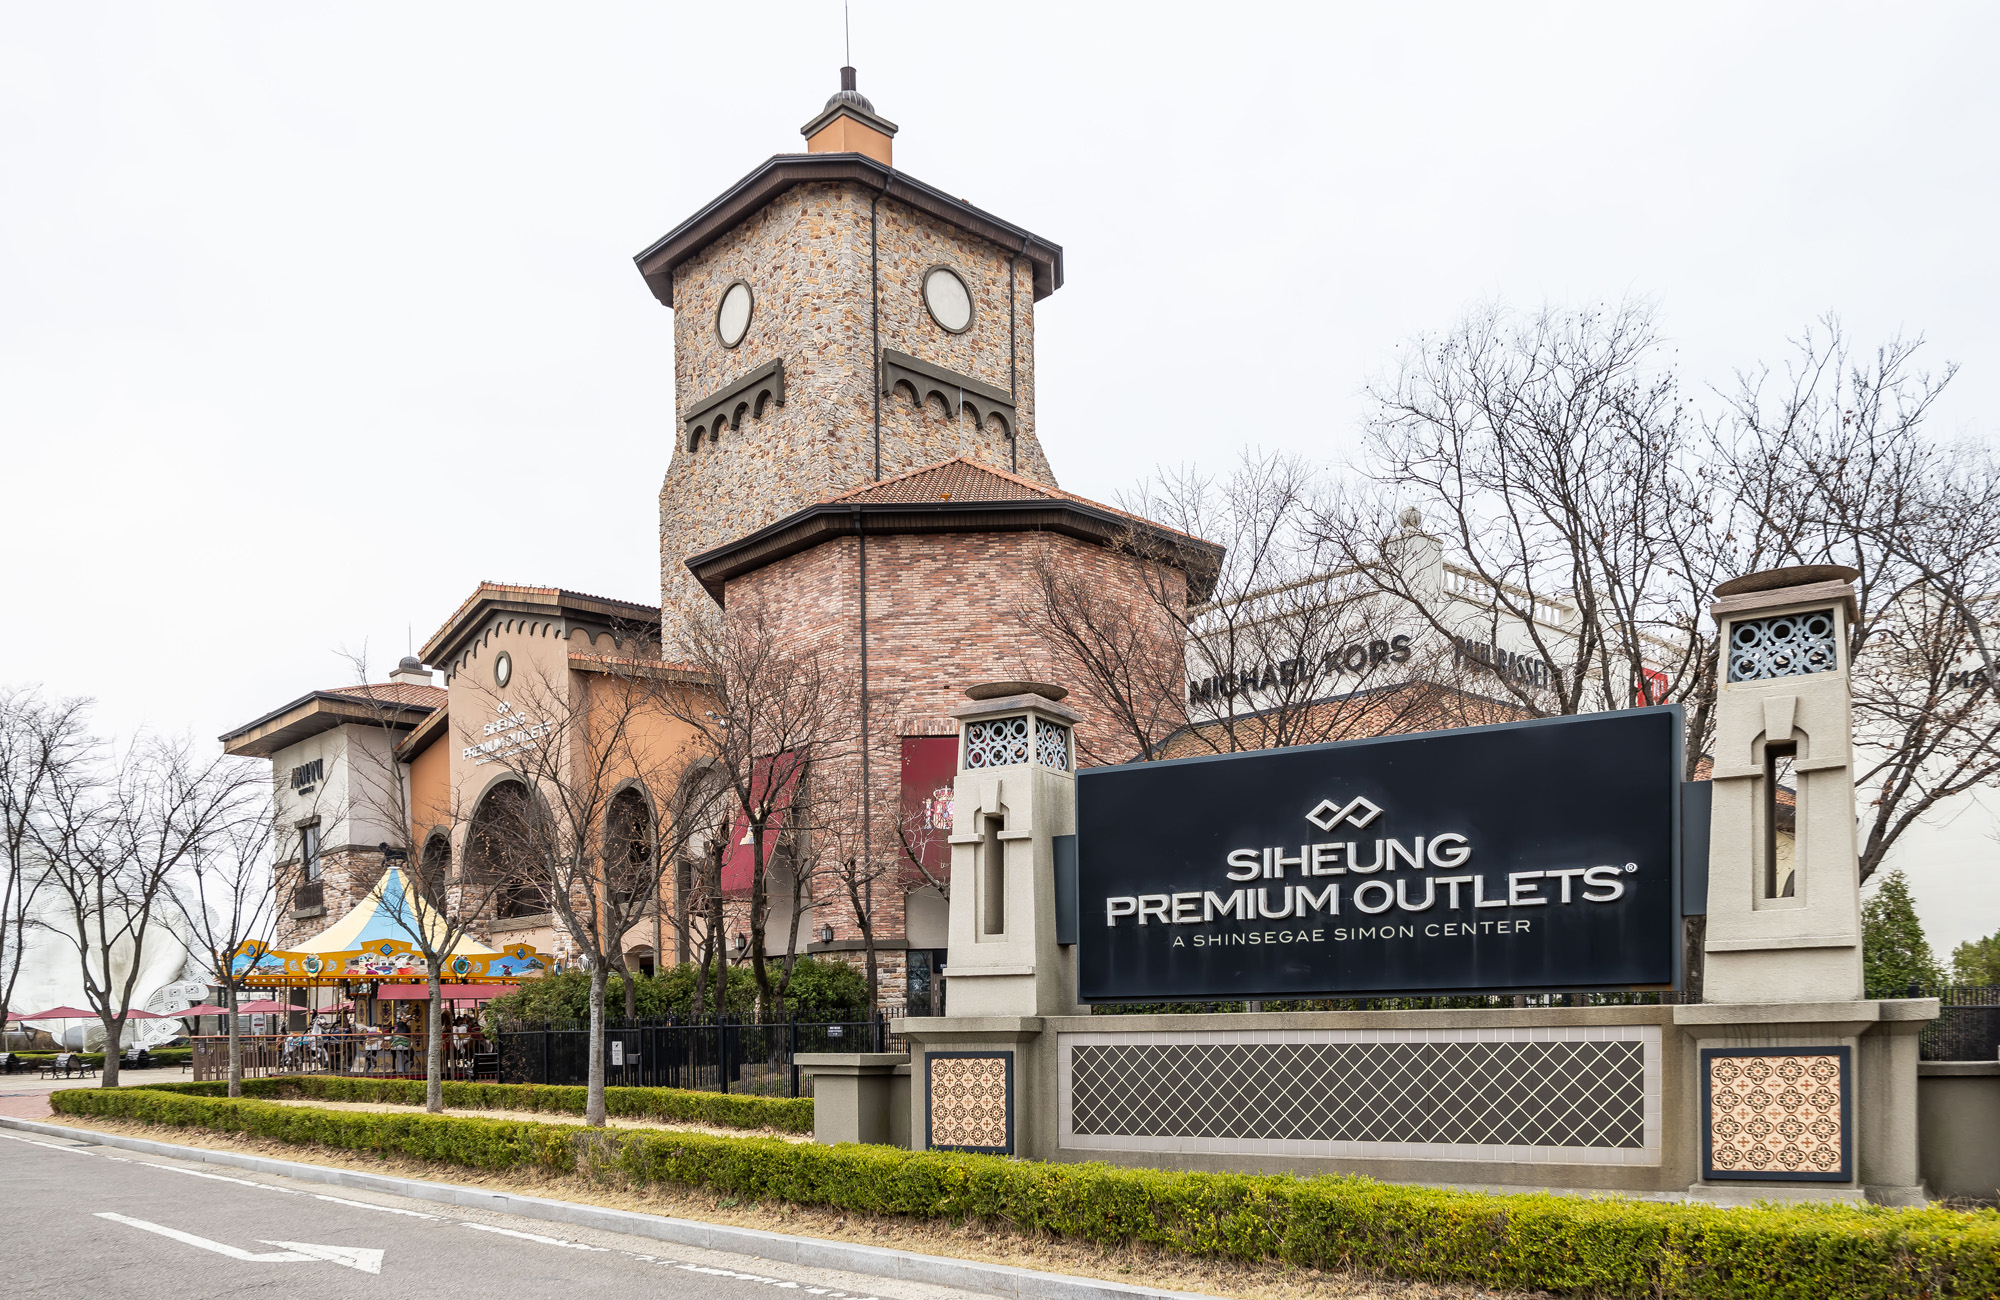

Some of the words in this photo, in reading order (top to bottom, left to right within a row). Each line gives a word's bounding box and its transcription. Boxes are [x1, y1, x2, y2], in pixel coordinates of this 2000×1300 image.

[1325, 634, 1411, 677] KORS
[483, 711, 526, 737] SIHEUNG
[462, 737, 505, 761] PREMIUM
[1226, 833, 1471, 881] SIHEUNG
[1106, 883, 1340, 927] PREMIUM
[1172, 935, 1186, 948] A
[1193, 929, 1325, 947] SHINSEGAE
[1334, 924, 1414, 942] SIMON
[1424, 919, 1532, 938] CENTER
